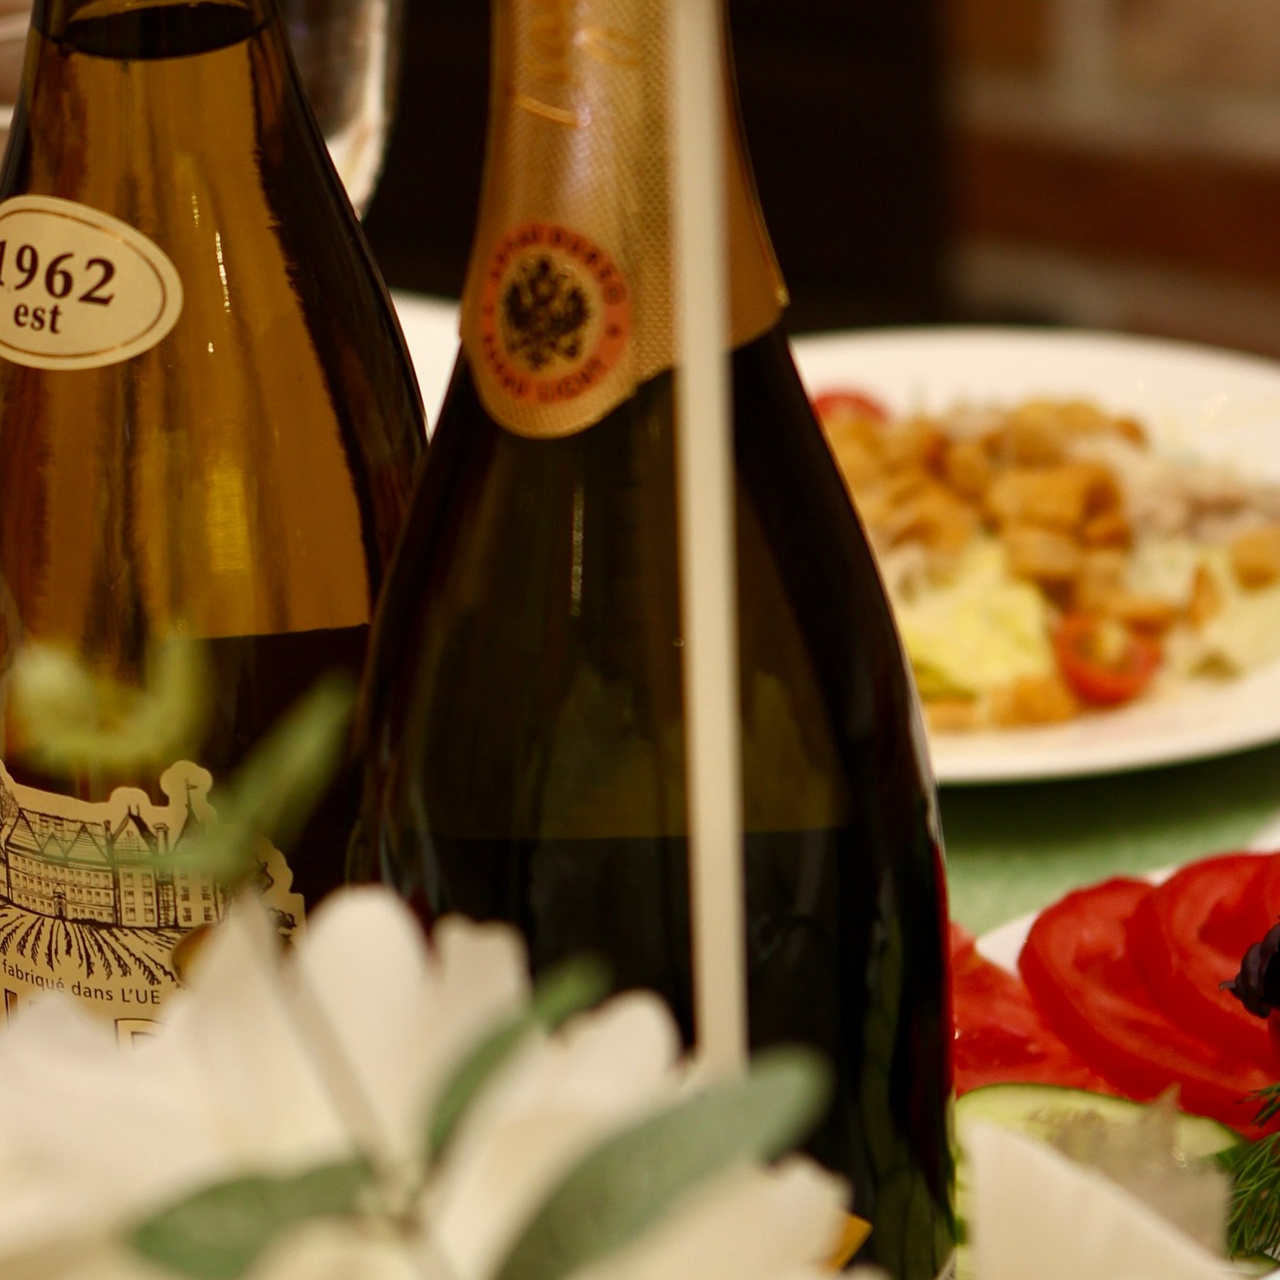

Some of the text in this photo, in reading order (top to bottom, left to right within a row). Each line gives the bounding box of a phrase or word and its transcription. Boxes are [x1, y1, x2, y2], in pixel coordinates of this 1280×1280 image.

[12, 302, 62, 334] est
[2, 958, 161, 1005] fabriqué dans L'UE
